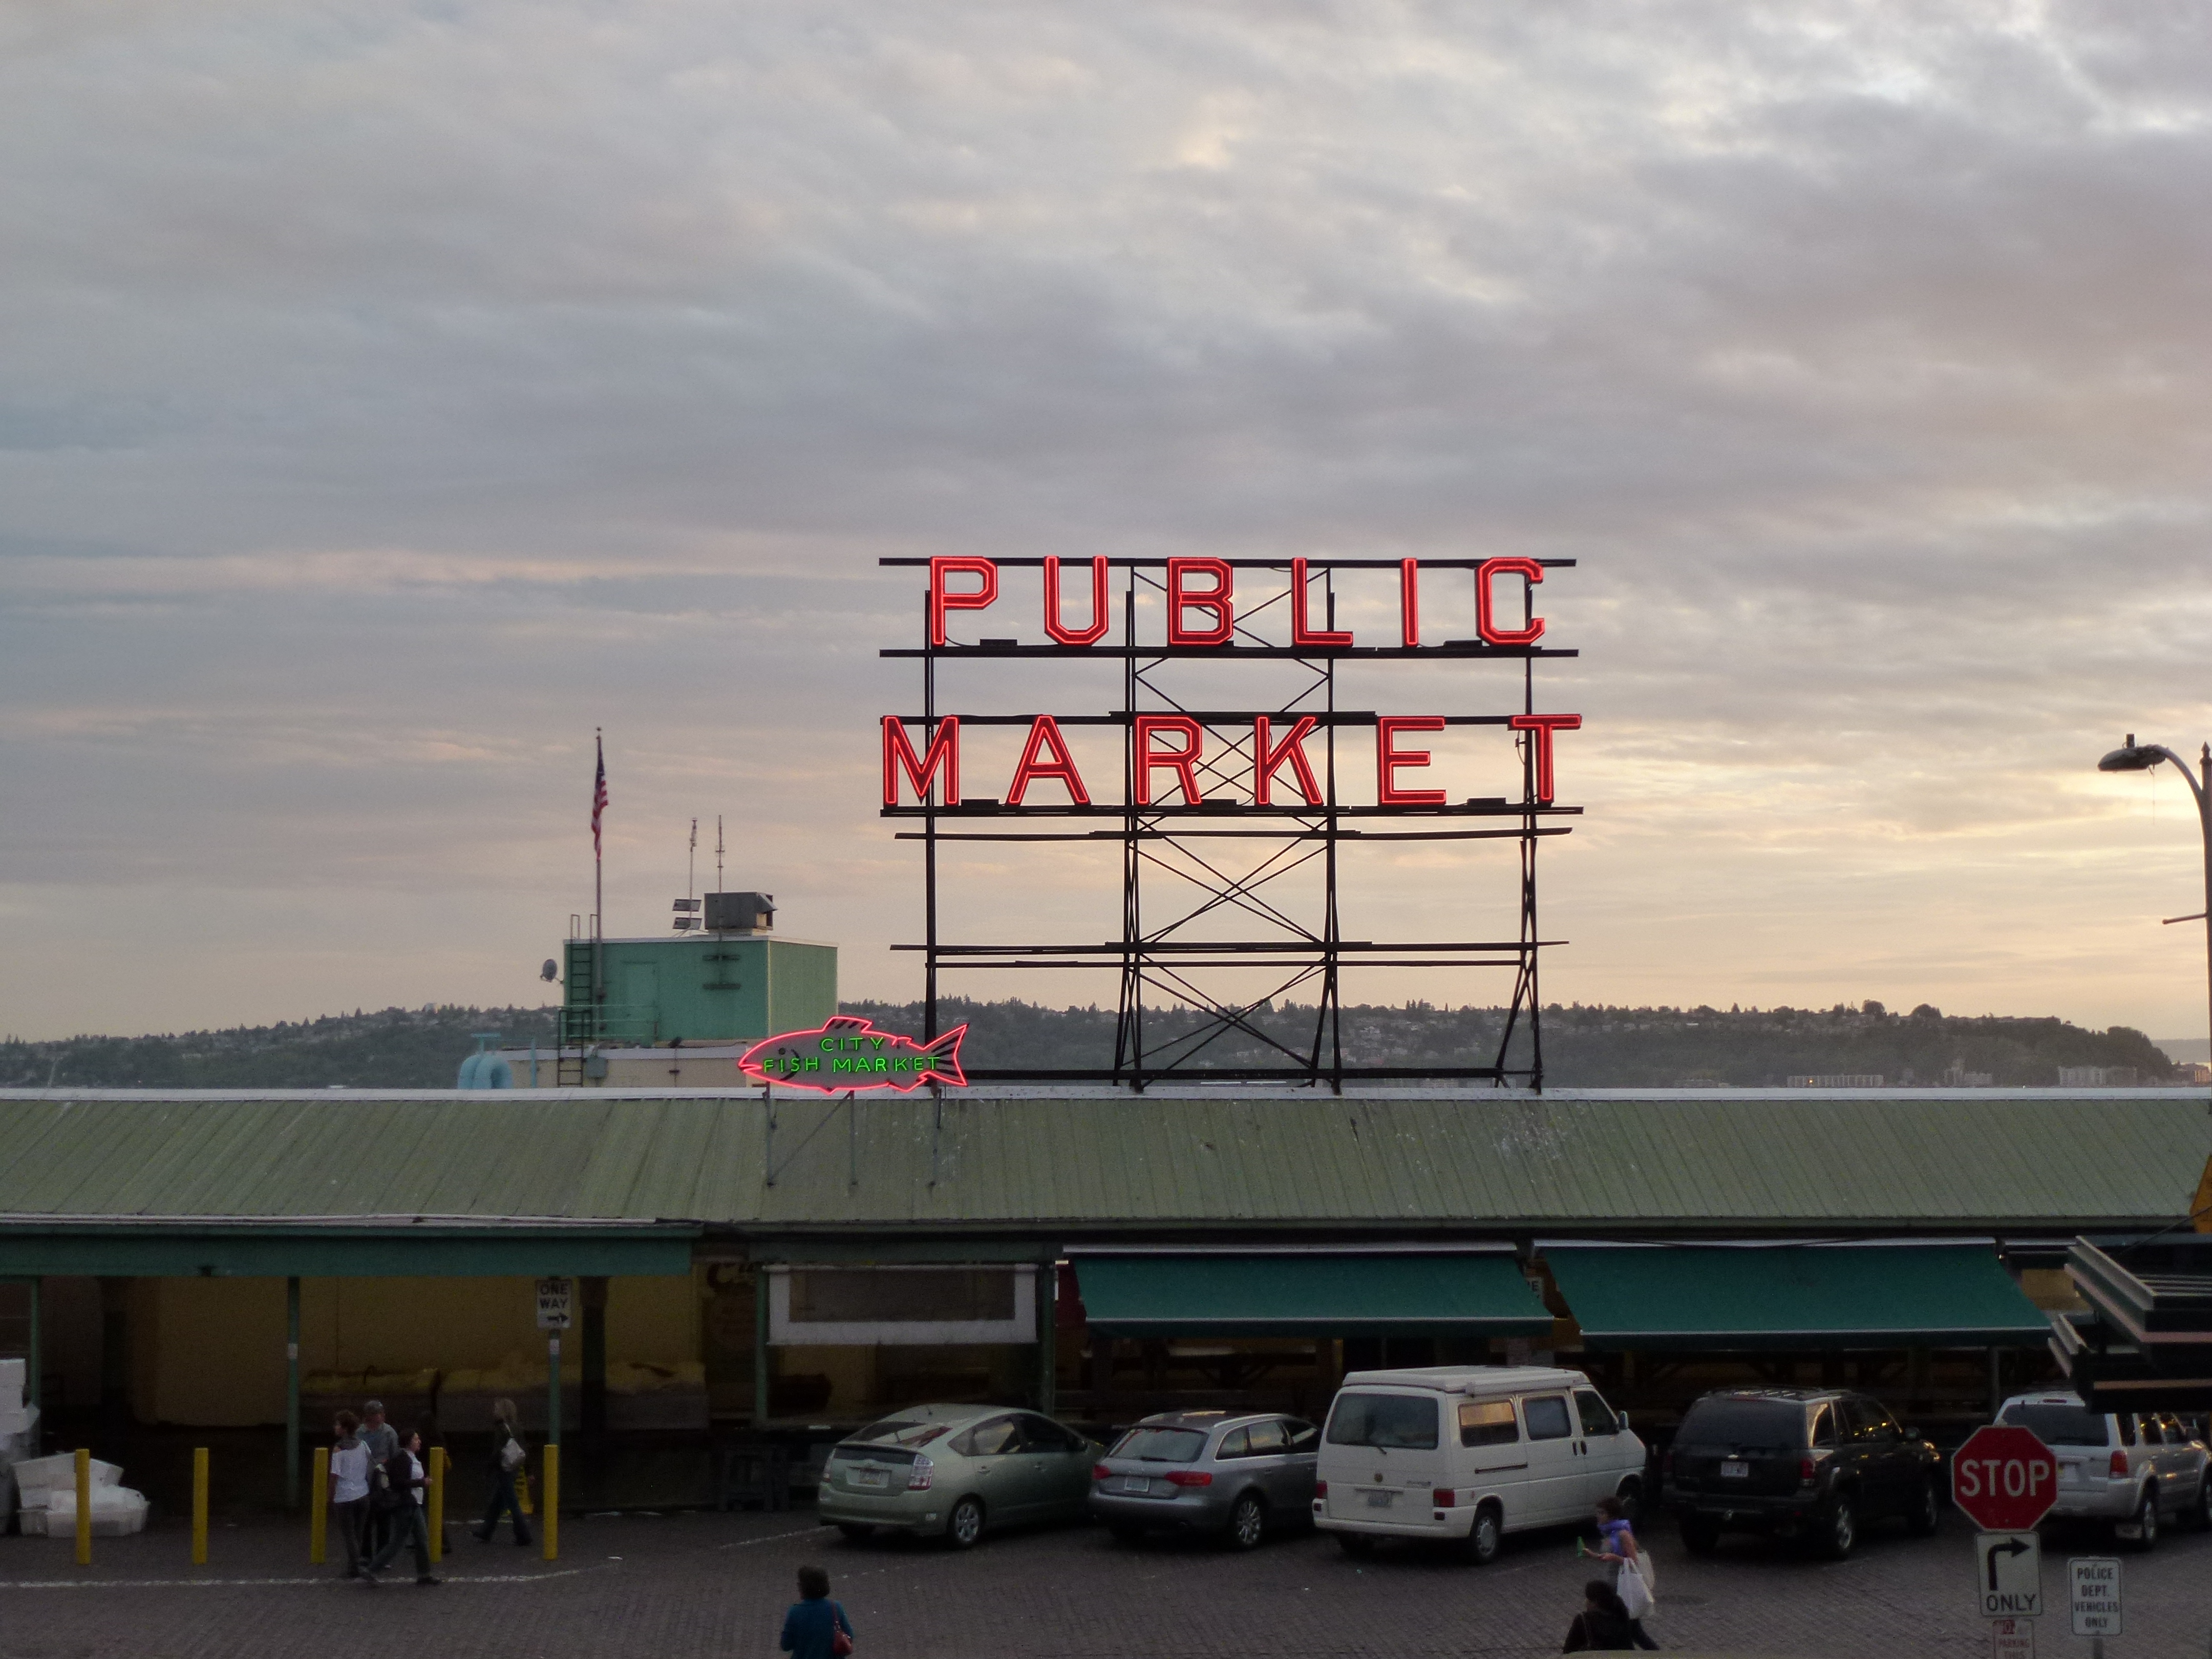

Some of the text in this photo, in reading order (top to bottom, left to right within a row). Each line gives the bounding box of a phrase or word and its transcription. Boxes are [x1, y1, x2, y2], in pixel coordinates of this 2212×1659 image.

[930, 556, 1545, 646] PUBLIC
[882, 713, 1583, 806] MARKET
[820, 1036, 884, 1052] CITY
[763, 1056, 940, 1073] FISH MARKET
[540, 1282, 567, 1295] ONE
[539, 1297, 568, 1309] WAY
[1960, 1458, 2051, 1498] STOP
[2077, 1567, 2114, 1580] POLICE
[2081, 1584, 2110, 1597] DEPT.
[1986, 1593, 2036, 1612] ONLY
[2074, 1601, 2119, 1612] VEHICLES
[2085, 1616, 2109, 1628] ONLY
